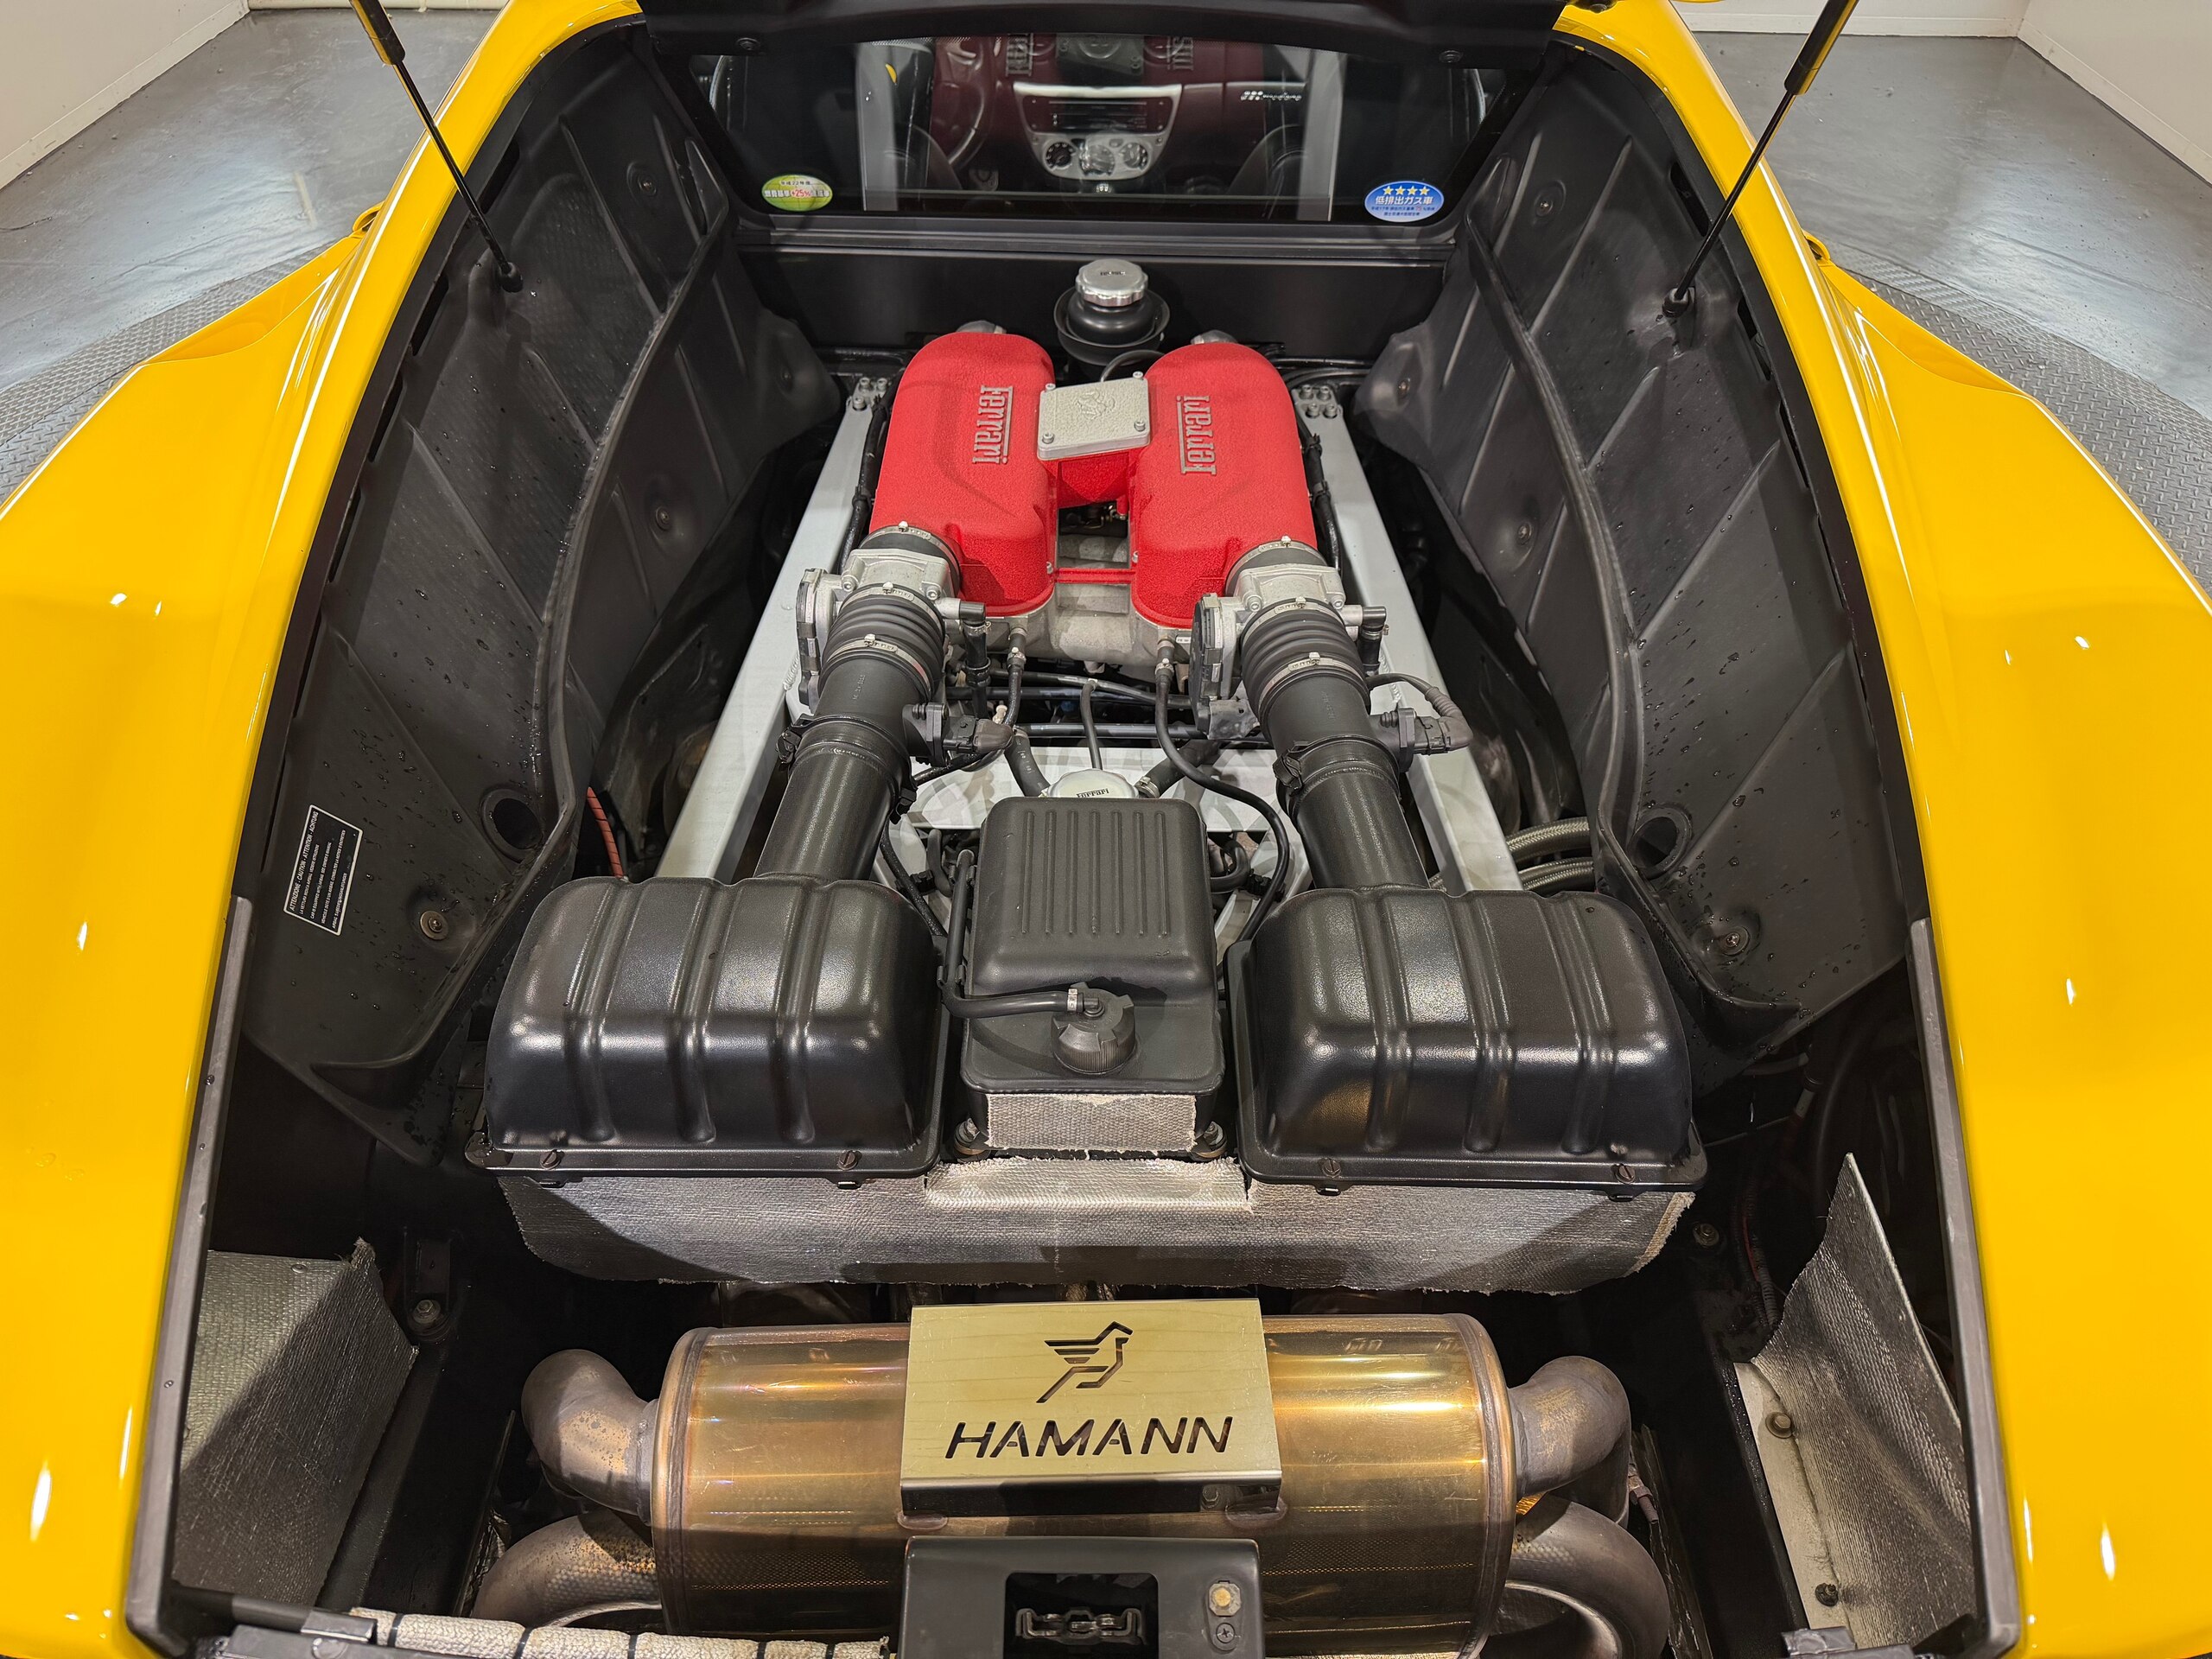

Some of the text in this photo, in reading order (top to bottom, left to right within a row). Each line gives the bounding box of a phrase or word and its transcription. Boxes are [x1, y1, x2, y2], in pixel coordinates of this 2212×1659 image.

[1376, 196, 1433, 205] 低排出ガス車
[972, 385, 1014, 465] Ferrari
[1177, 395, 1217, 475] Ferrari
[289, 811, 319, 911] ATTENZIONE CAUTION ATTENTION ACHTUNG
[944, 1415, 1233, 1459] HAMANN
